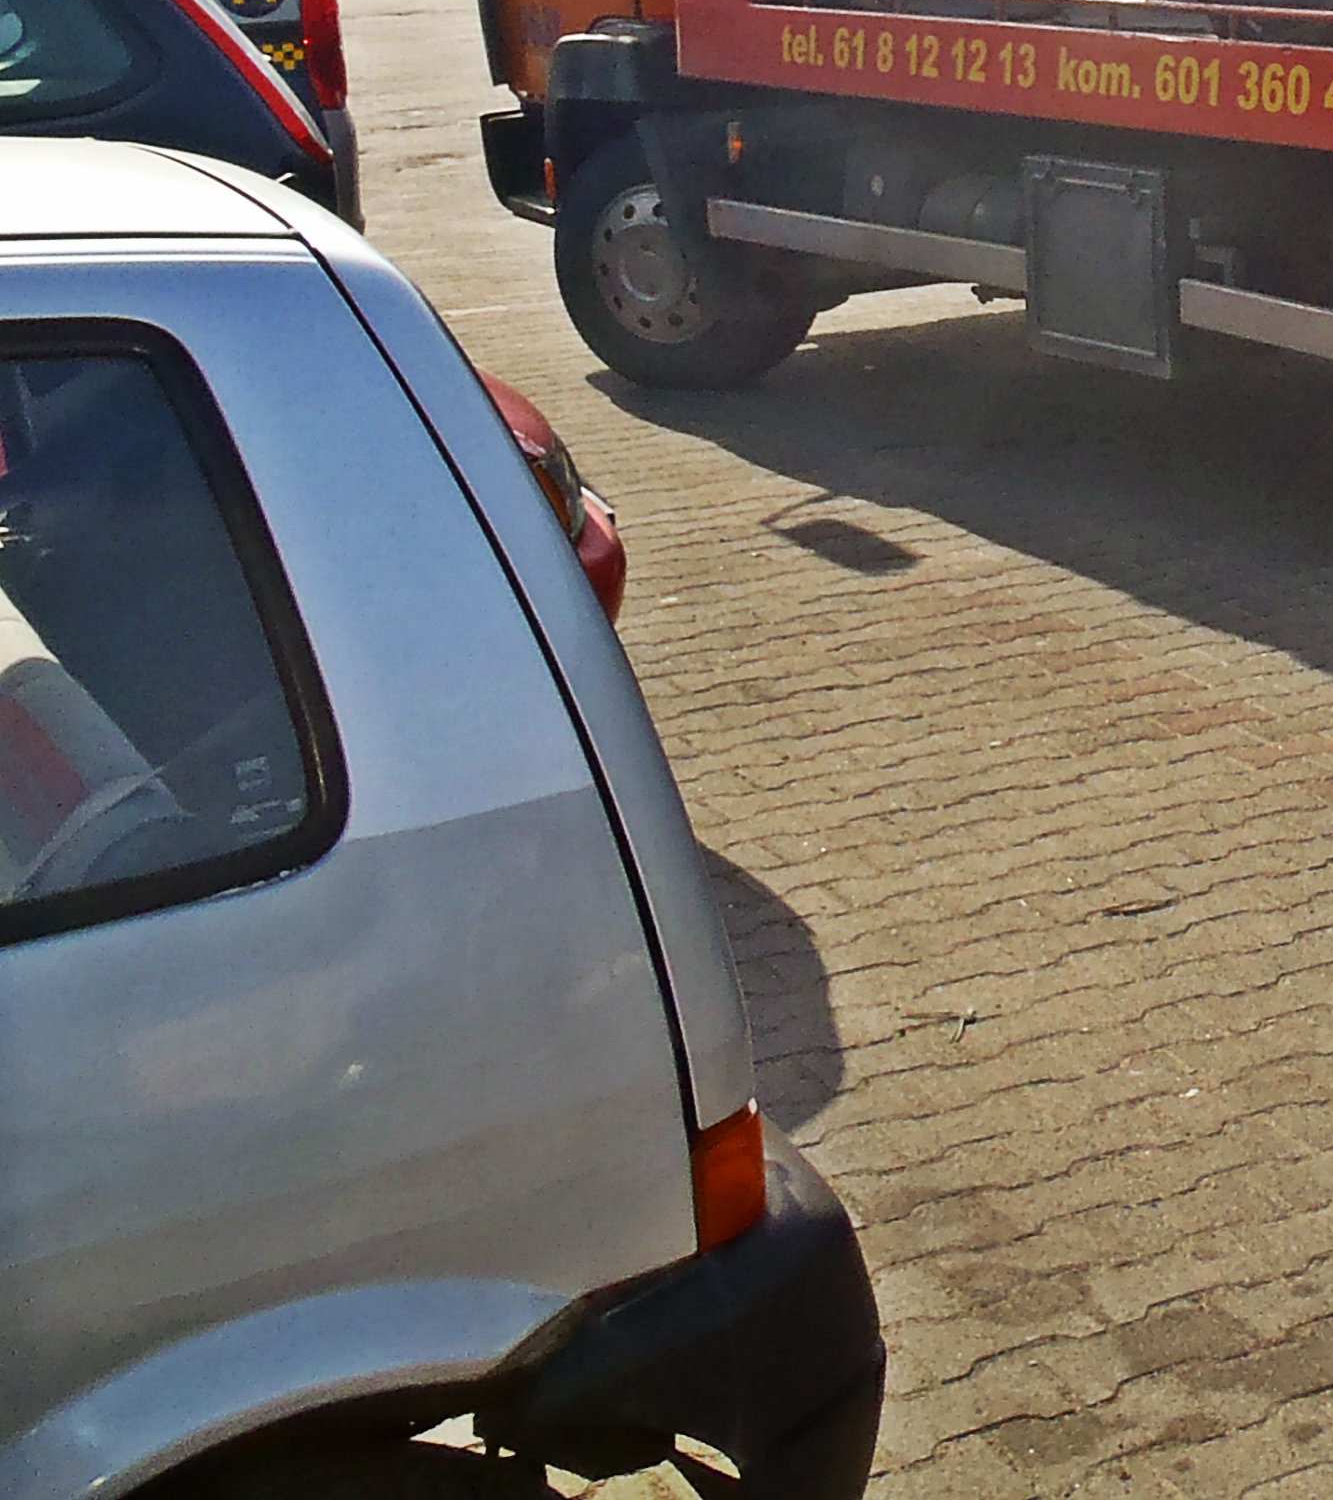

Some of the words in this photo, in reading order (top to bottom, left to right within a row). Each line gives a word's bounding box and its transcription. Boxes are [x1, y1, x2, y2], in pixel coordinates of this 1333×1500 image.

[781, 24, 824, 66] tel.
[833, 27, 865, 70] 61
[877, 31, 894, 73] 8
[906, 33, 940, 78] 12
[952, 37, 987, 83] 12
[999, 41, 1036, 88] 13
[1058, 47, 1140, 99] kom.
[1155, 55, 1220, 106] 601
[1237, 61, 1311, 115] 360
